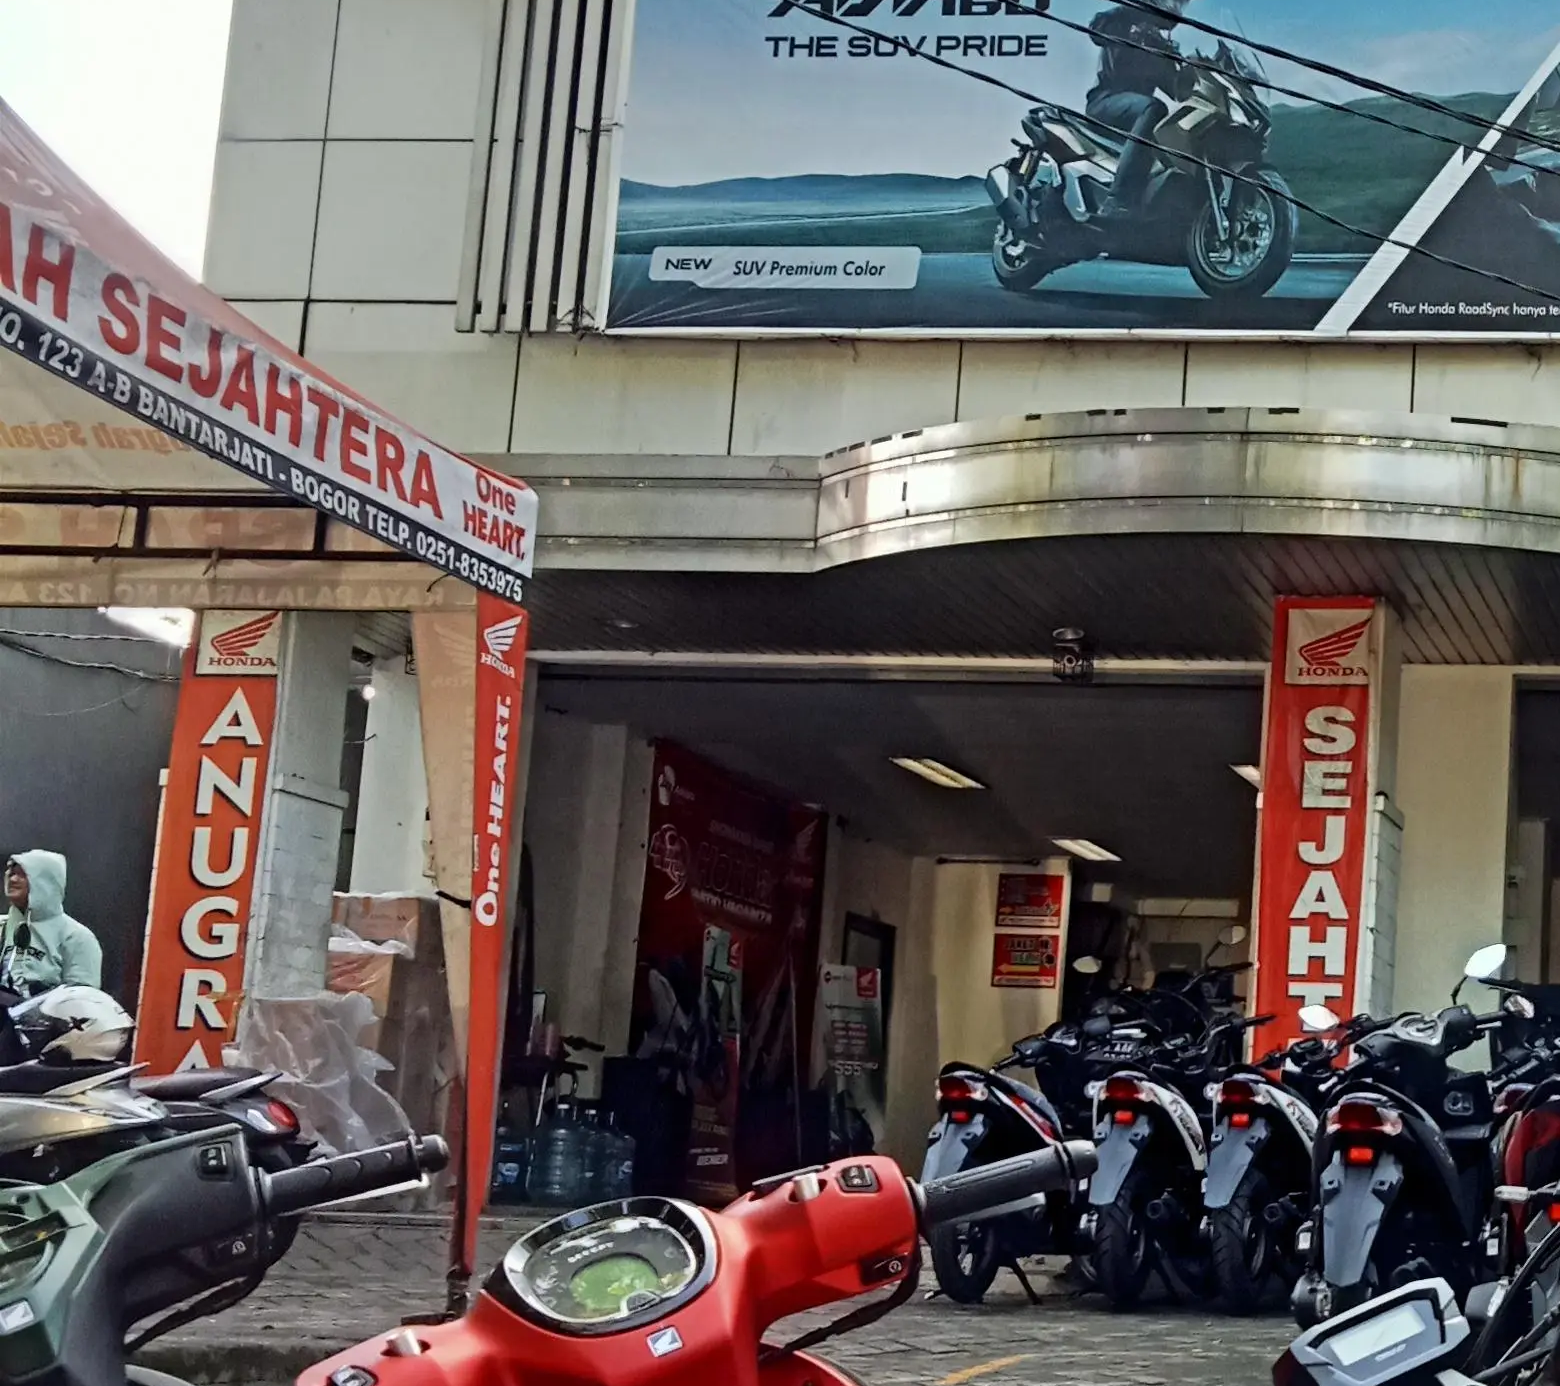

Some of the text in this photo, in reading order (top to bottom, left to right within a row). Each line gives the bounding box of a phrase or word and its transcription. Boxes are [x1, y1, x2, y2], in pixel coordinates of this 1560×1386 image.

[765, 33, 1049, 59] THE SUV PRIDE
[664, 257, 887, 279] NEW SUV Premium Color
[1419, 301, 1456, 315] Honda
[1458, 301, 1510, 318] RoadSync
[1512, 302, 1547, 318] hanya
[97, 272, 443, 521] SEJAHTERA
[0, 306, 25, 351] O.
[38, 332, 84, 380] 123
[87, 357, 131, 404] A-B
[137, 385, 274, 481] BANTARJATI
[290, 467, 361, 524] BOGOR
[366, 504, 412, 549] TELP.
[416, 531, 523, 603] 0251-8353975
[475, 467, 516, 516] One
[462, 500, 526, 561] HEART.
[208, 655, 277, 668] HONDA
[1297, 665, 1369, 678] HONDA
[475, 694, 512, 927] One HEART.
[1286, 705, 1357, 1072] SEJAHT
